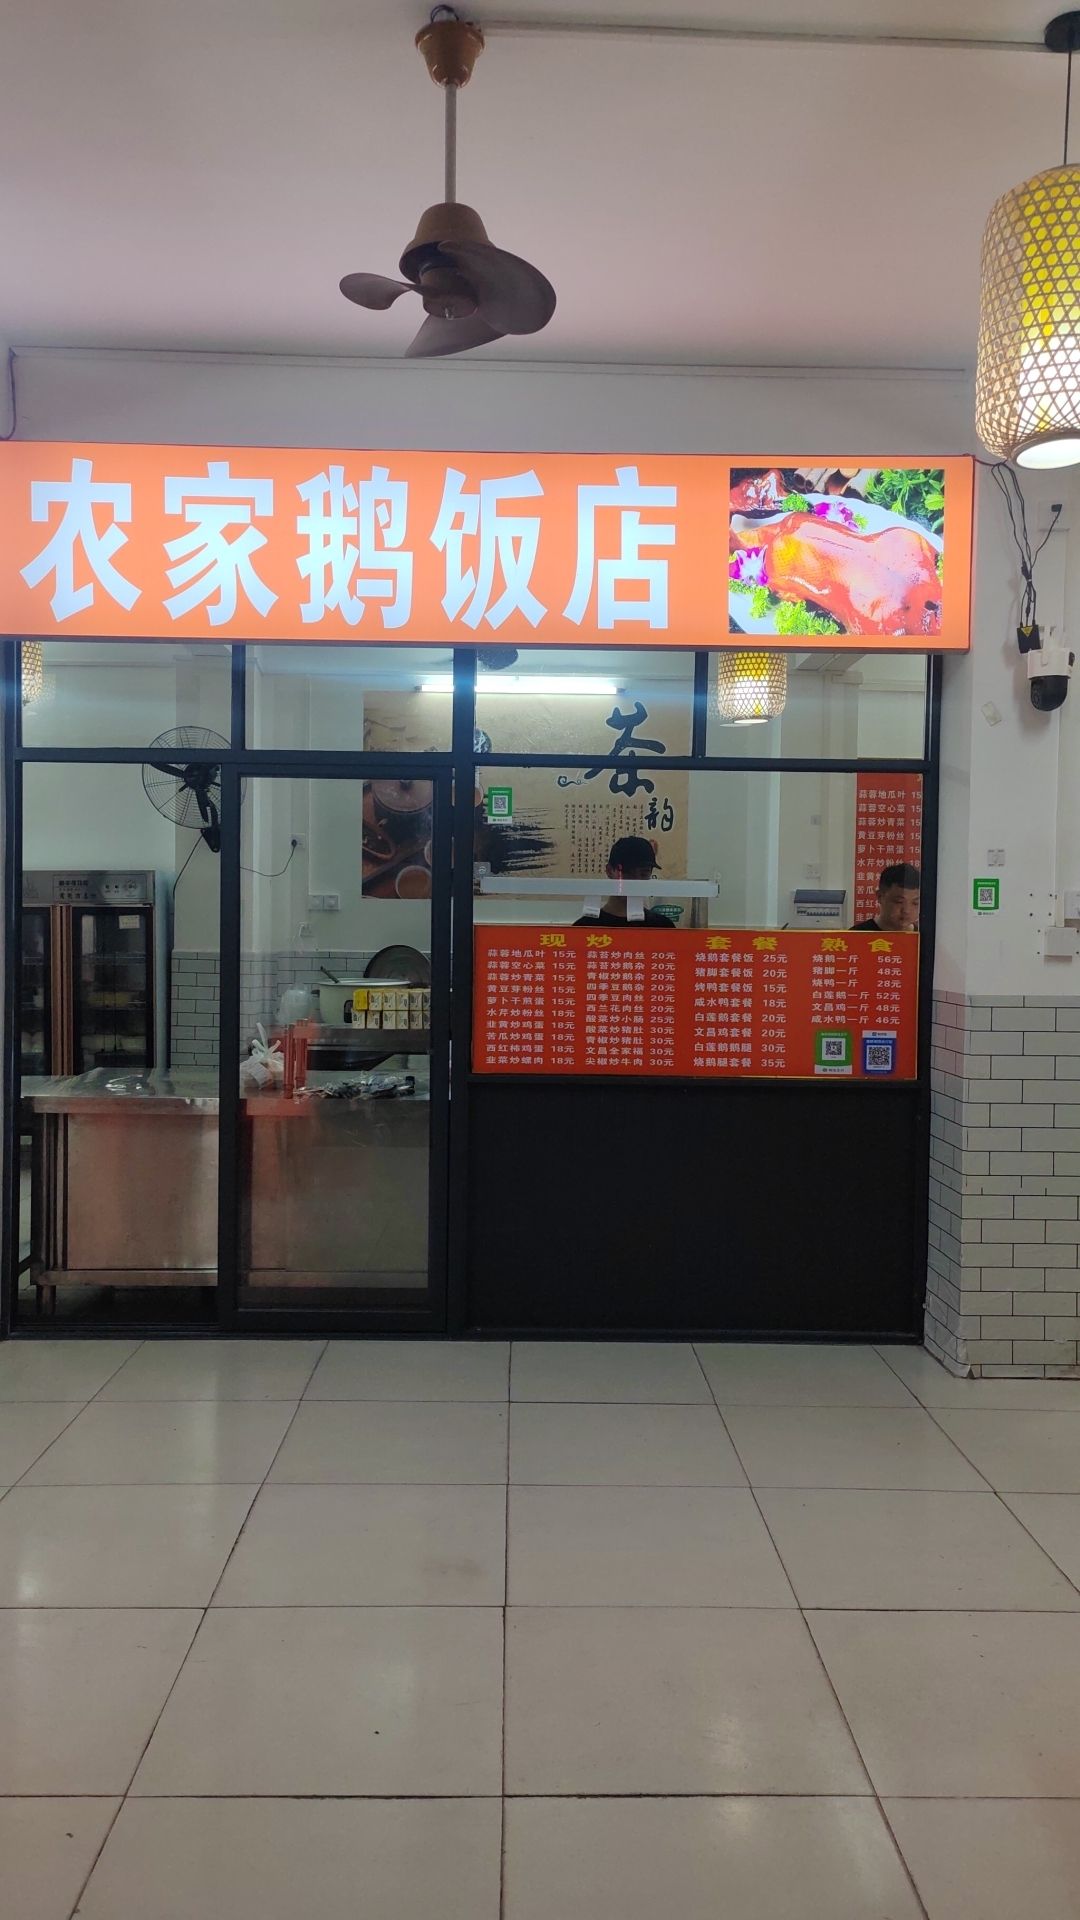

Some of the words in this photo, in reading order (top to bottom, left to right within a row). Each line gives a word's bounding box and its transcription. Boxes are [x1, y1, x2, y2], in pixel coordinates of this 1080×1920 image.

[18, 457, 679, 631] 农家鹅饭店
[539, 934, 614, 948] 现炒
[705, 936, 779, 951] 套餐
[820, 937, 894, 952] 熟食
[553, 950, 577, 959] 15元
[652, 952, 676, 960] 20元
[763, 953, 788, 964] 25元
[878, 955, 902, 964] 56元
[553, 962, 576, 970] 15元
[652, 962, 676, 971] 20元
[763, 968, 788, 978] 20元
[878, 967, 902, 976] 48元
[553, 974, 576, 982] 15元
[652, 973, 676, 981] 20元
[651, 983, 675, 992] 20元
[878, 979, 902, 988] 28元
[553, 986, 576, 994] 15元
[764, 983, 787, 994] 15元
[651, 994, 675, 1003] 20元
[877, 992, 901, 1001] 52元
[552, 998, 576, 1006] 15元
[764, 998, 787, 1008] 18元
[651, 1005, 675, 1013] 20元
[876, 1004, 900, 1013] 48元
[552, 1009, 576, 1018] 18元
[762, 1013, 787, 1023] 20元
[651, 1016, 675, 1024] 25元
[876, 1016, 900, 1025] 46元
[552, 1021, 575, 1030] 18元
[651, 1026, 675, 1035] 30元
[762, 1028, 786, 1038] 20元
[552, 1033, 575, 1042] 18元
[651, 1037, 675, 1045] 30元
[552, 1045, 575, 1053] 18元
[650, 1047, 674, 1056] 30元
[762, 1043, 786, 1053] 30元
[552, 1057, 575, 1065] 18元
[650, 1058, 674, 1067] 30元
[762, 1058, 786, 1068] 35元
